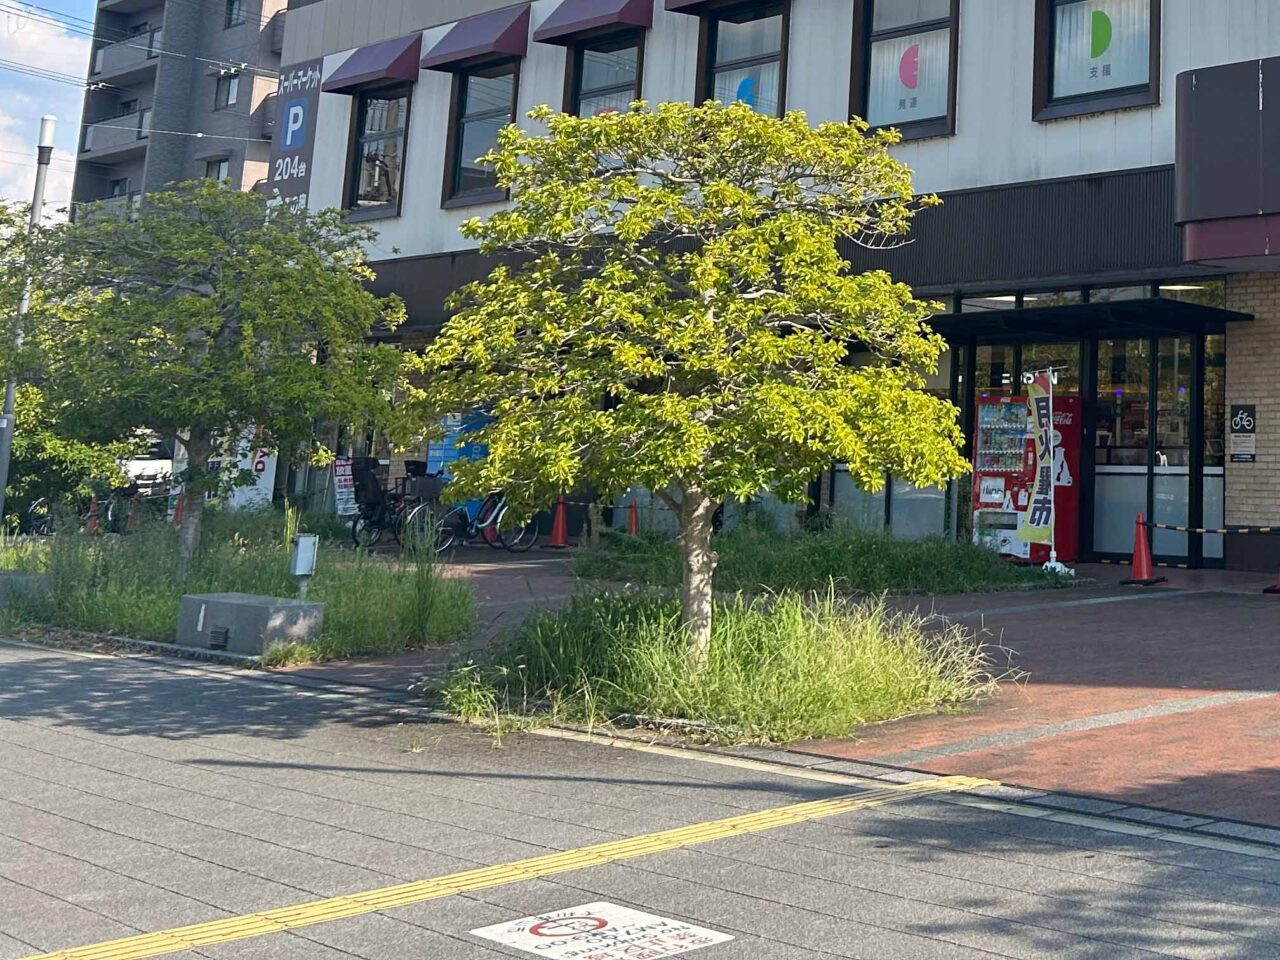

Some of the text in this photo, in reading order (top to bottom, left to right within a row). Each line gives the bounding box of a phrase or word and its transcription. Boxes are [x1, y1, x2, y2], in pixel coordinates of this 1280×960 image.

[278, 64, 321, 97] スーパーマーケット
[286, 105, 303, 145] P
[274, 155, 307, 182] 204台
